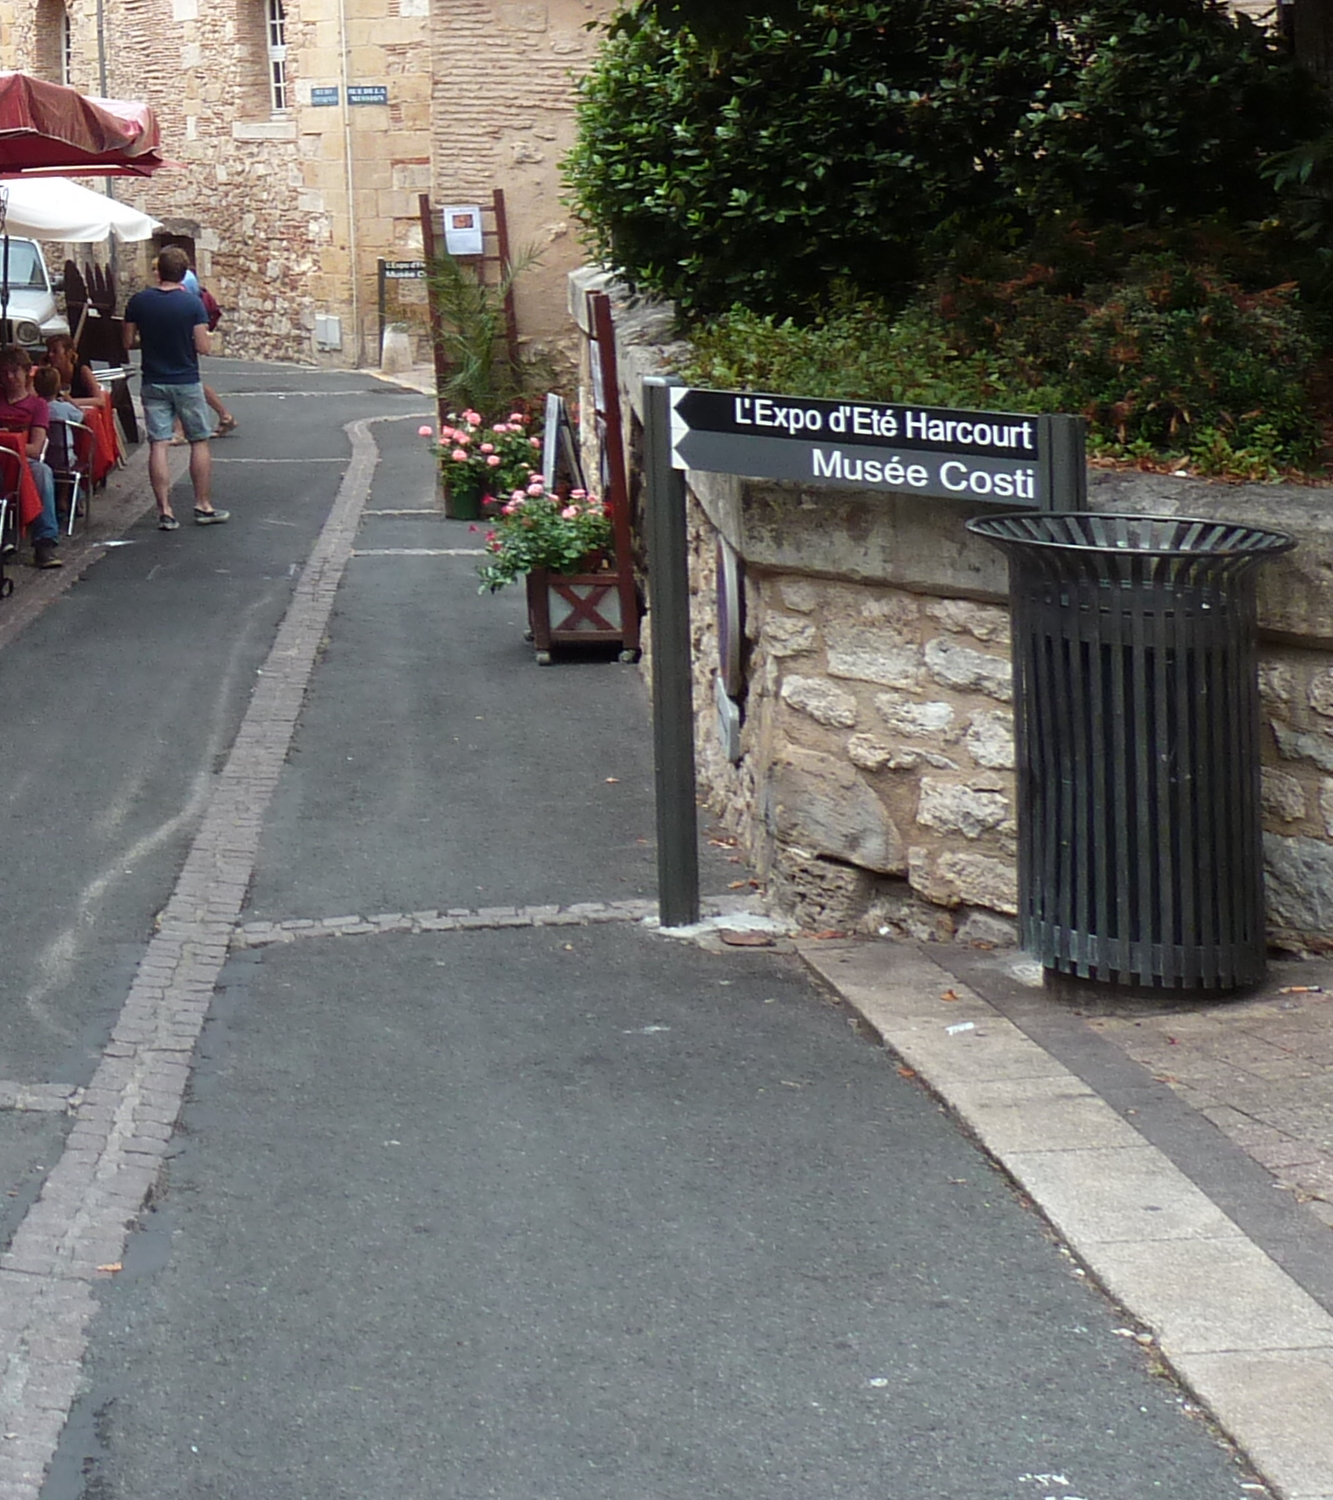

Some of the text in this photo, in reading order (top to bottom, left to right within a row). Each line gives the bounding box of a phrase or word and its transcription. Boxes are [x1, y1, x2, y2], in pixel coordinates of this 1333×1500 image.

[385, 270, 415, 278] Musée
[735, 397, 1033, 450] L'Expo d'Eté Harcourt
[812, 449, 1034, 499] Musée Costi
